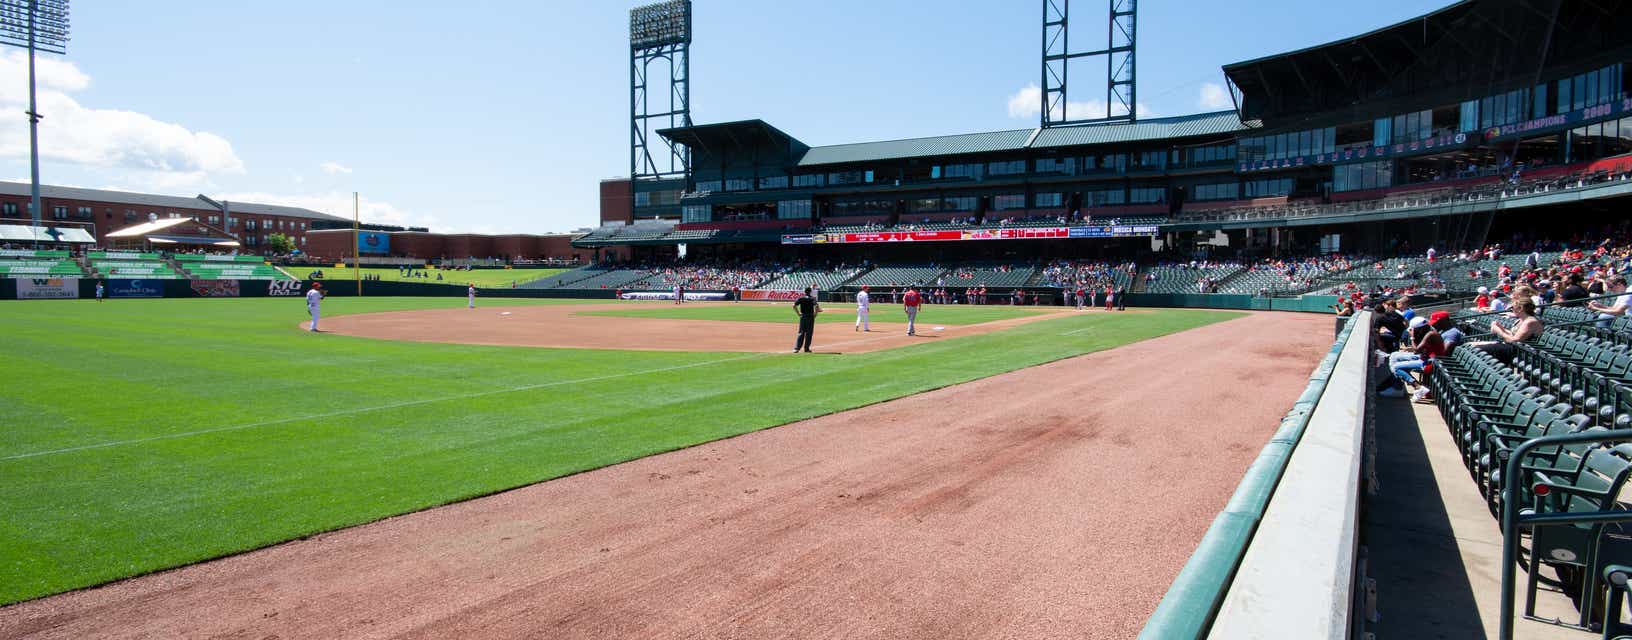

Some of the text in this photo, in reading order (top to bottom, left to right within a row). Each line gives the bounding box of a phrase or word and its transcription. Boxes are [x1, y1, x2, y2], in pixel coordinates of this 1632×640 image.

[1501, 126, 1516, 136] PCL
[1516, 114, 1566, 133] CHAMPIONS
[768, 290, 806, 300] AutoZon
